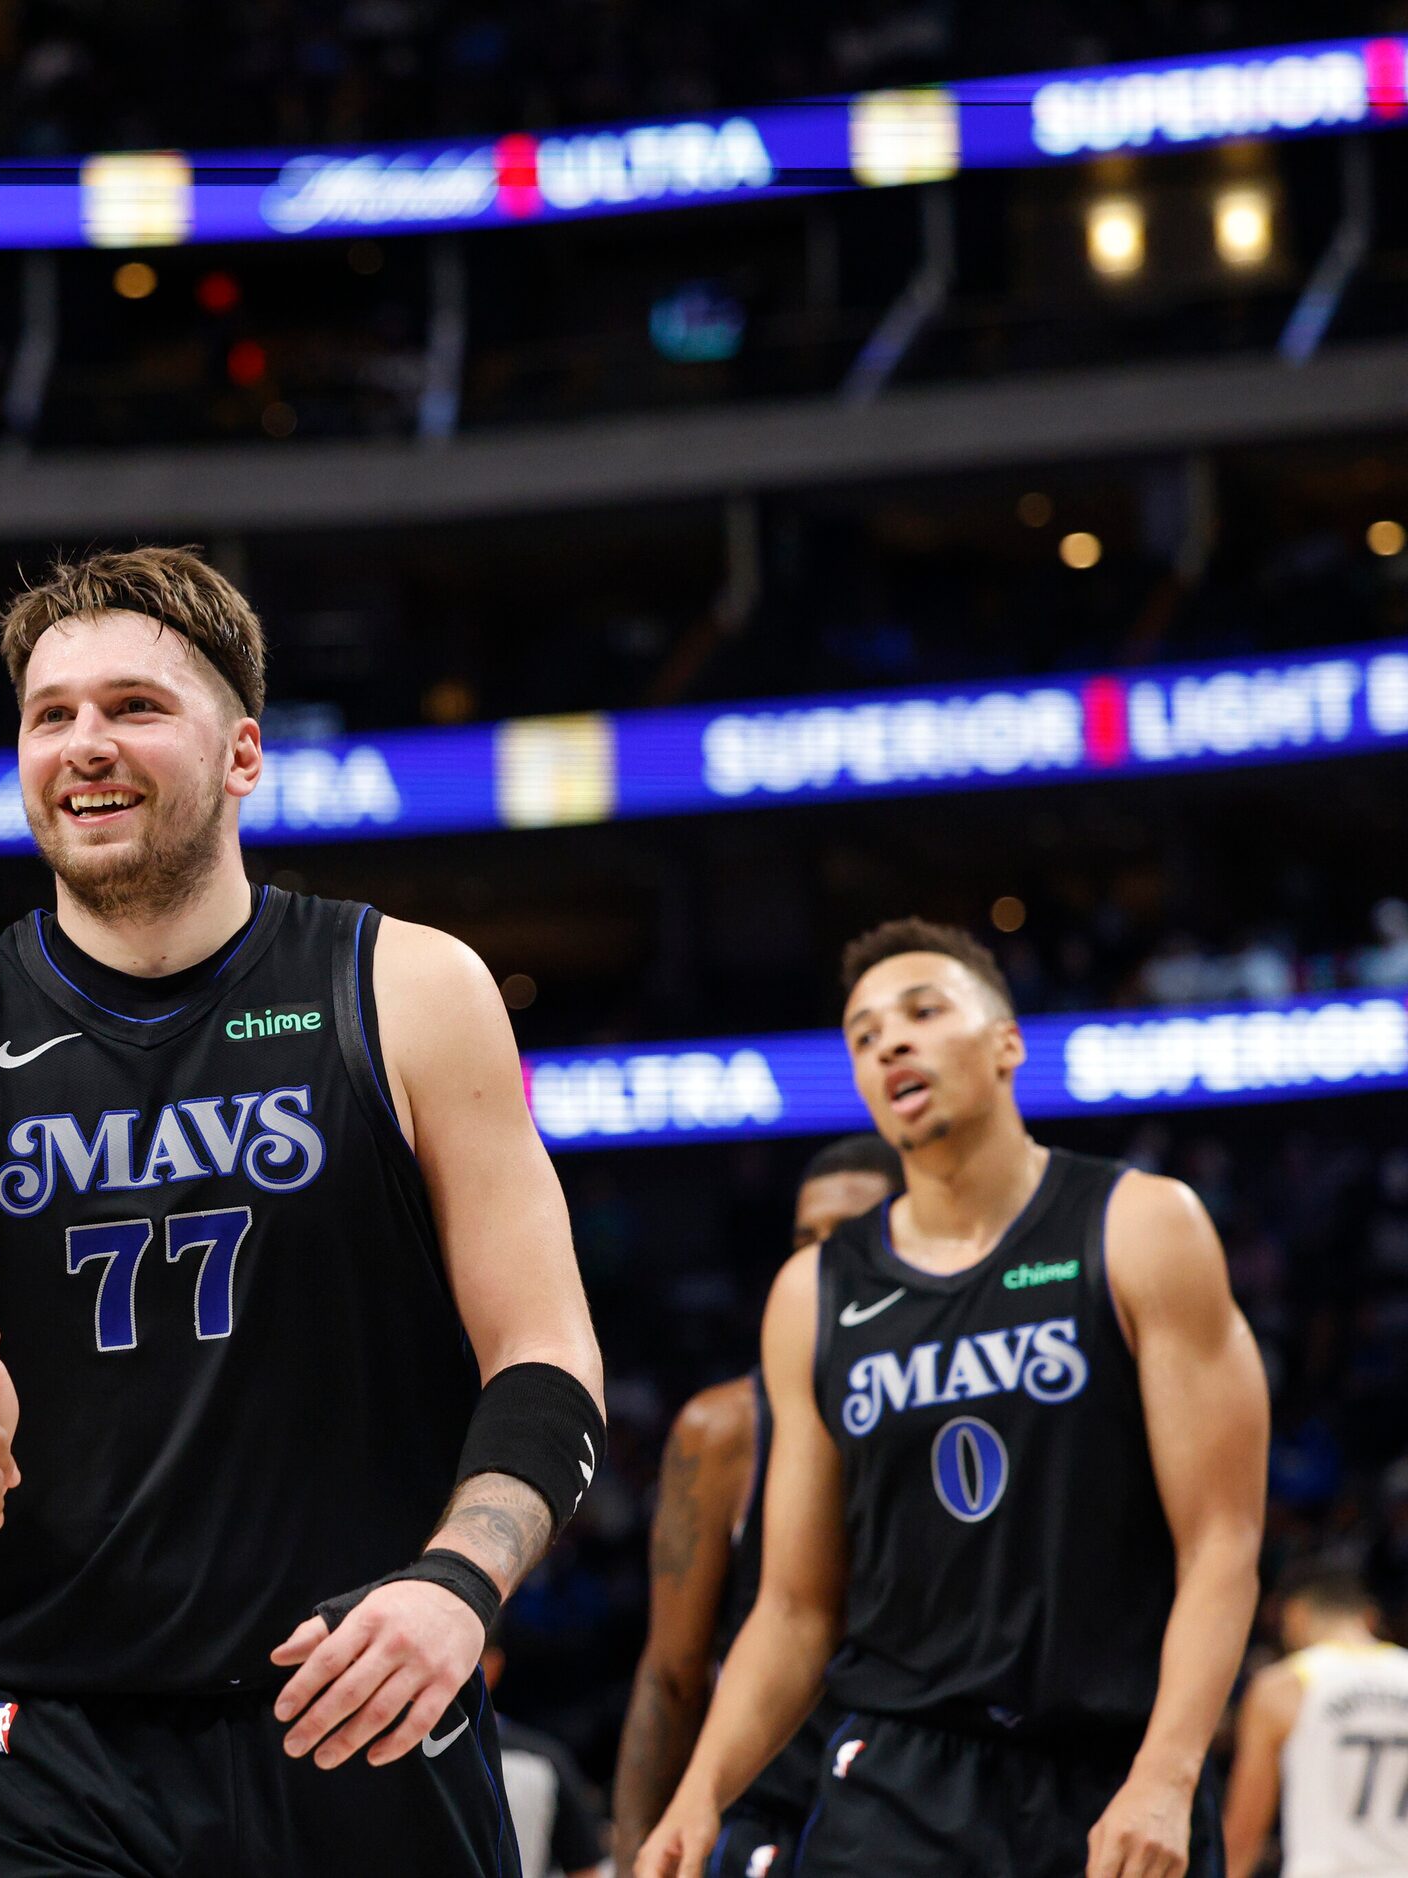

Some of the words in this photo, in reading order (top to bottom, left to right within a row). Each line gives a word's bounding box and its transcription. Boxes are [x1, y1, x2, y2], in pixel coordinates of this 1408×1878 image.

[1032, 51, 1366, 156] SUPERIOR
[537, 116, 774, 210] ULTRA
[702, 688, 1083, 797] SUPERIOR
[1129, 659, 1362, 762] LIGHT
[240, 746, 402, 831] TRA
[225, 1007, 323, 1042] chime
[1064, 999, 1405, 1103] SUPERIOR
[531, 1048, 783, 1139] ULTRA
[65, 1206, 252, 1352] 77
[1002, 1259, 1080, 1290] chime
[842, 1317, 1088, 1437] MAVS
[932, 1416, 1009, 1523] 0
